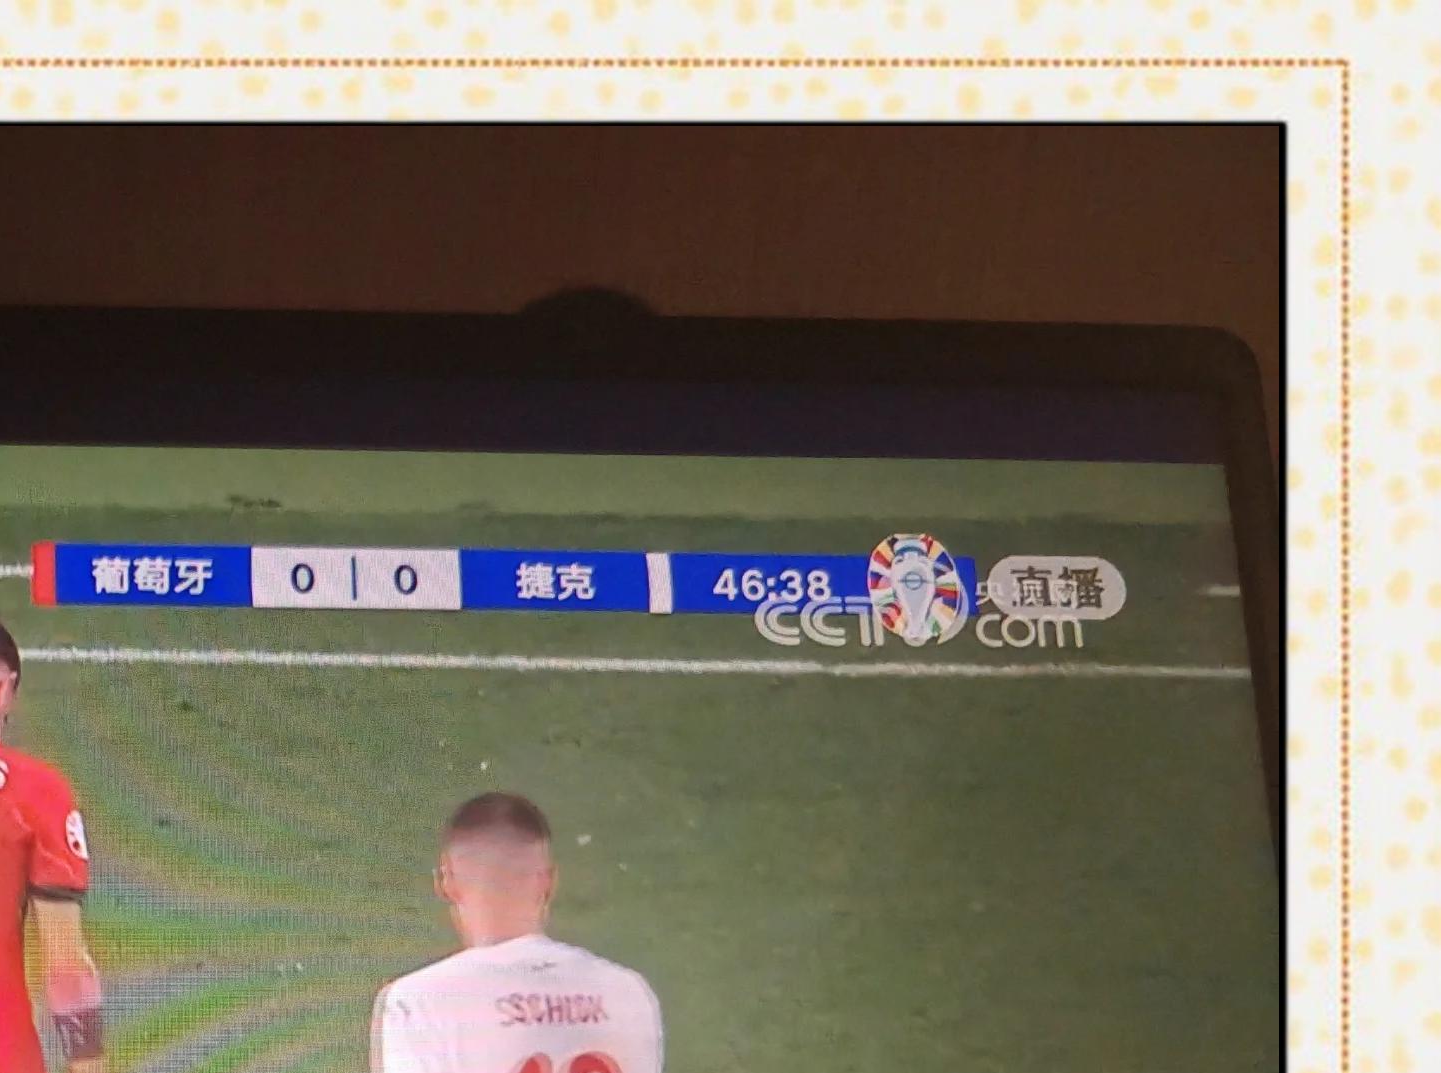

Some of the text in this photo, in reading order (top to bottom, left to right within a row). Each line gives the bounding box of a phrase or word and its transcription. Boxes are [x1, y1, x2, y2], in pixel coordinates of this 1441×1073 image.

[91, 556, 832, 602] 葡萄牙 0 0 捷克 46:38
